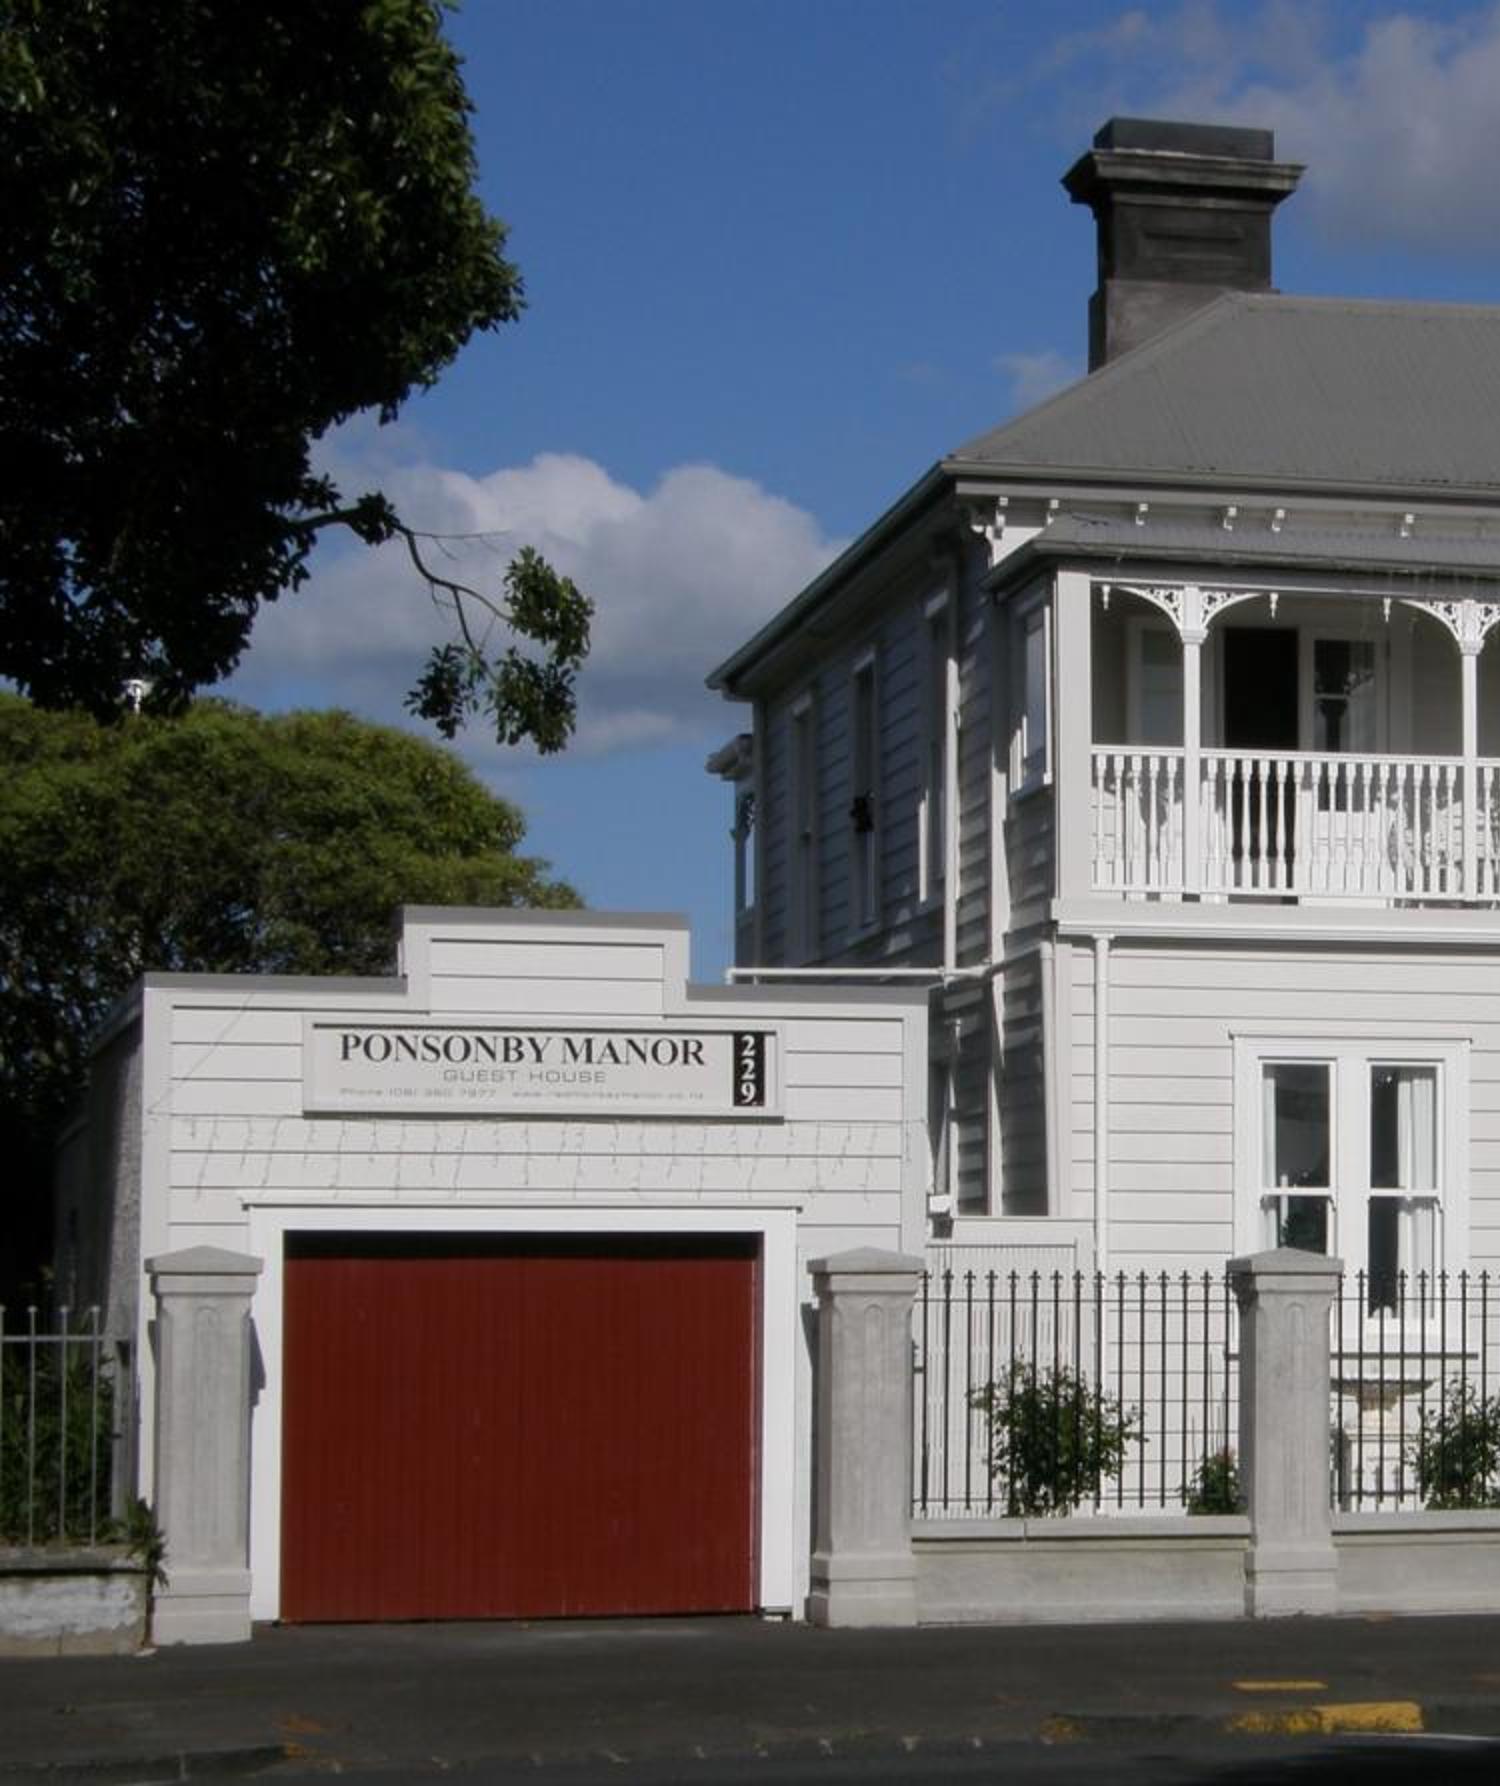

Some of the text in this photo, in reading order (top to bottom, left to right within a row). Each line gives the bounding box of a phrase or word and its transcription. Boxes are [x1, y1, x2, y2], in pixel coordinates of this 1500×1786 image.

[340, 1033, 706, 1066] PONSONBY MANOR
[442, 1069, 606, 1083] GUEST HOUSE
[740, 1034, 757, 1105] 229
